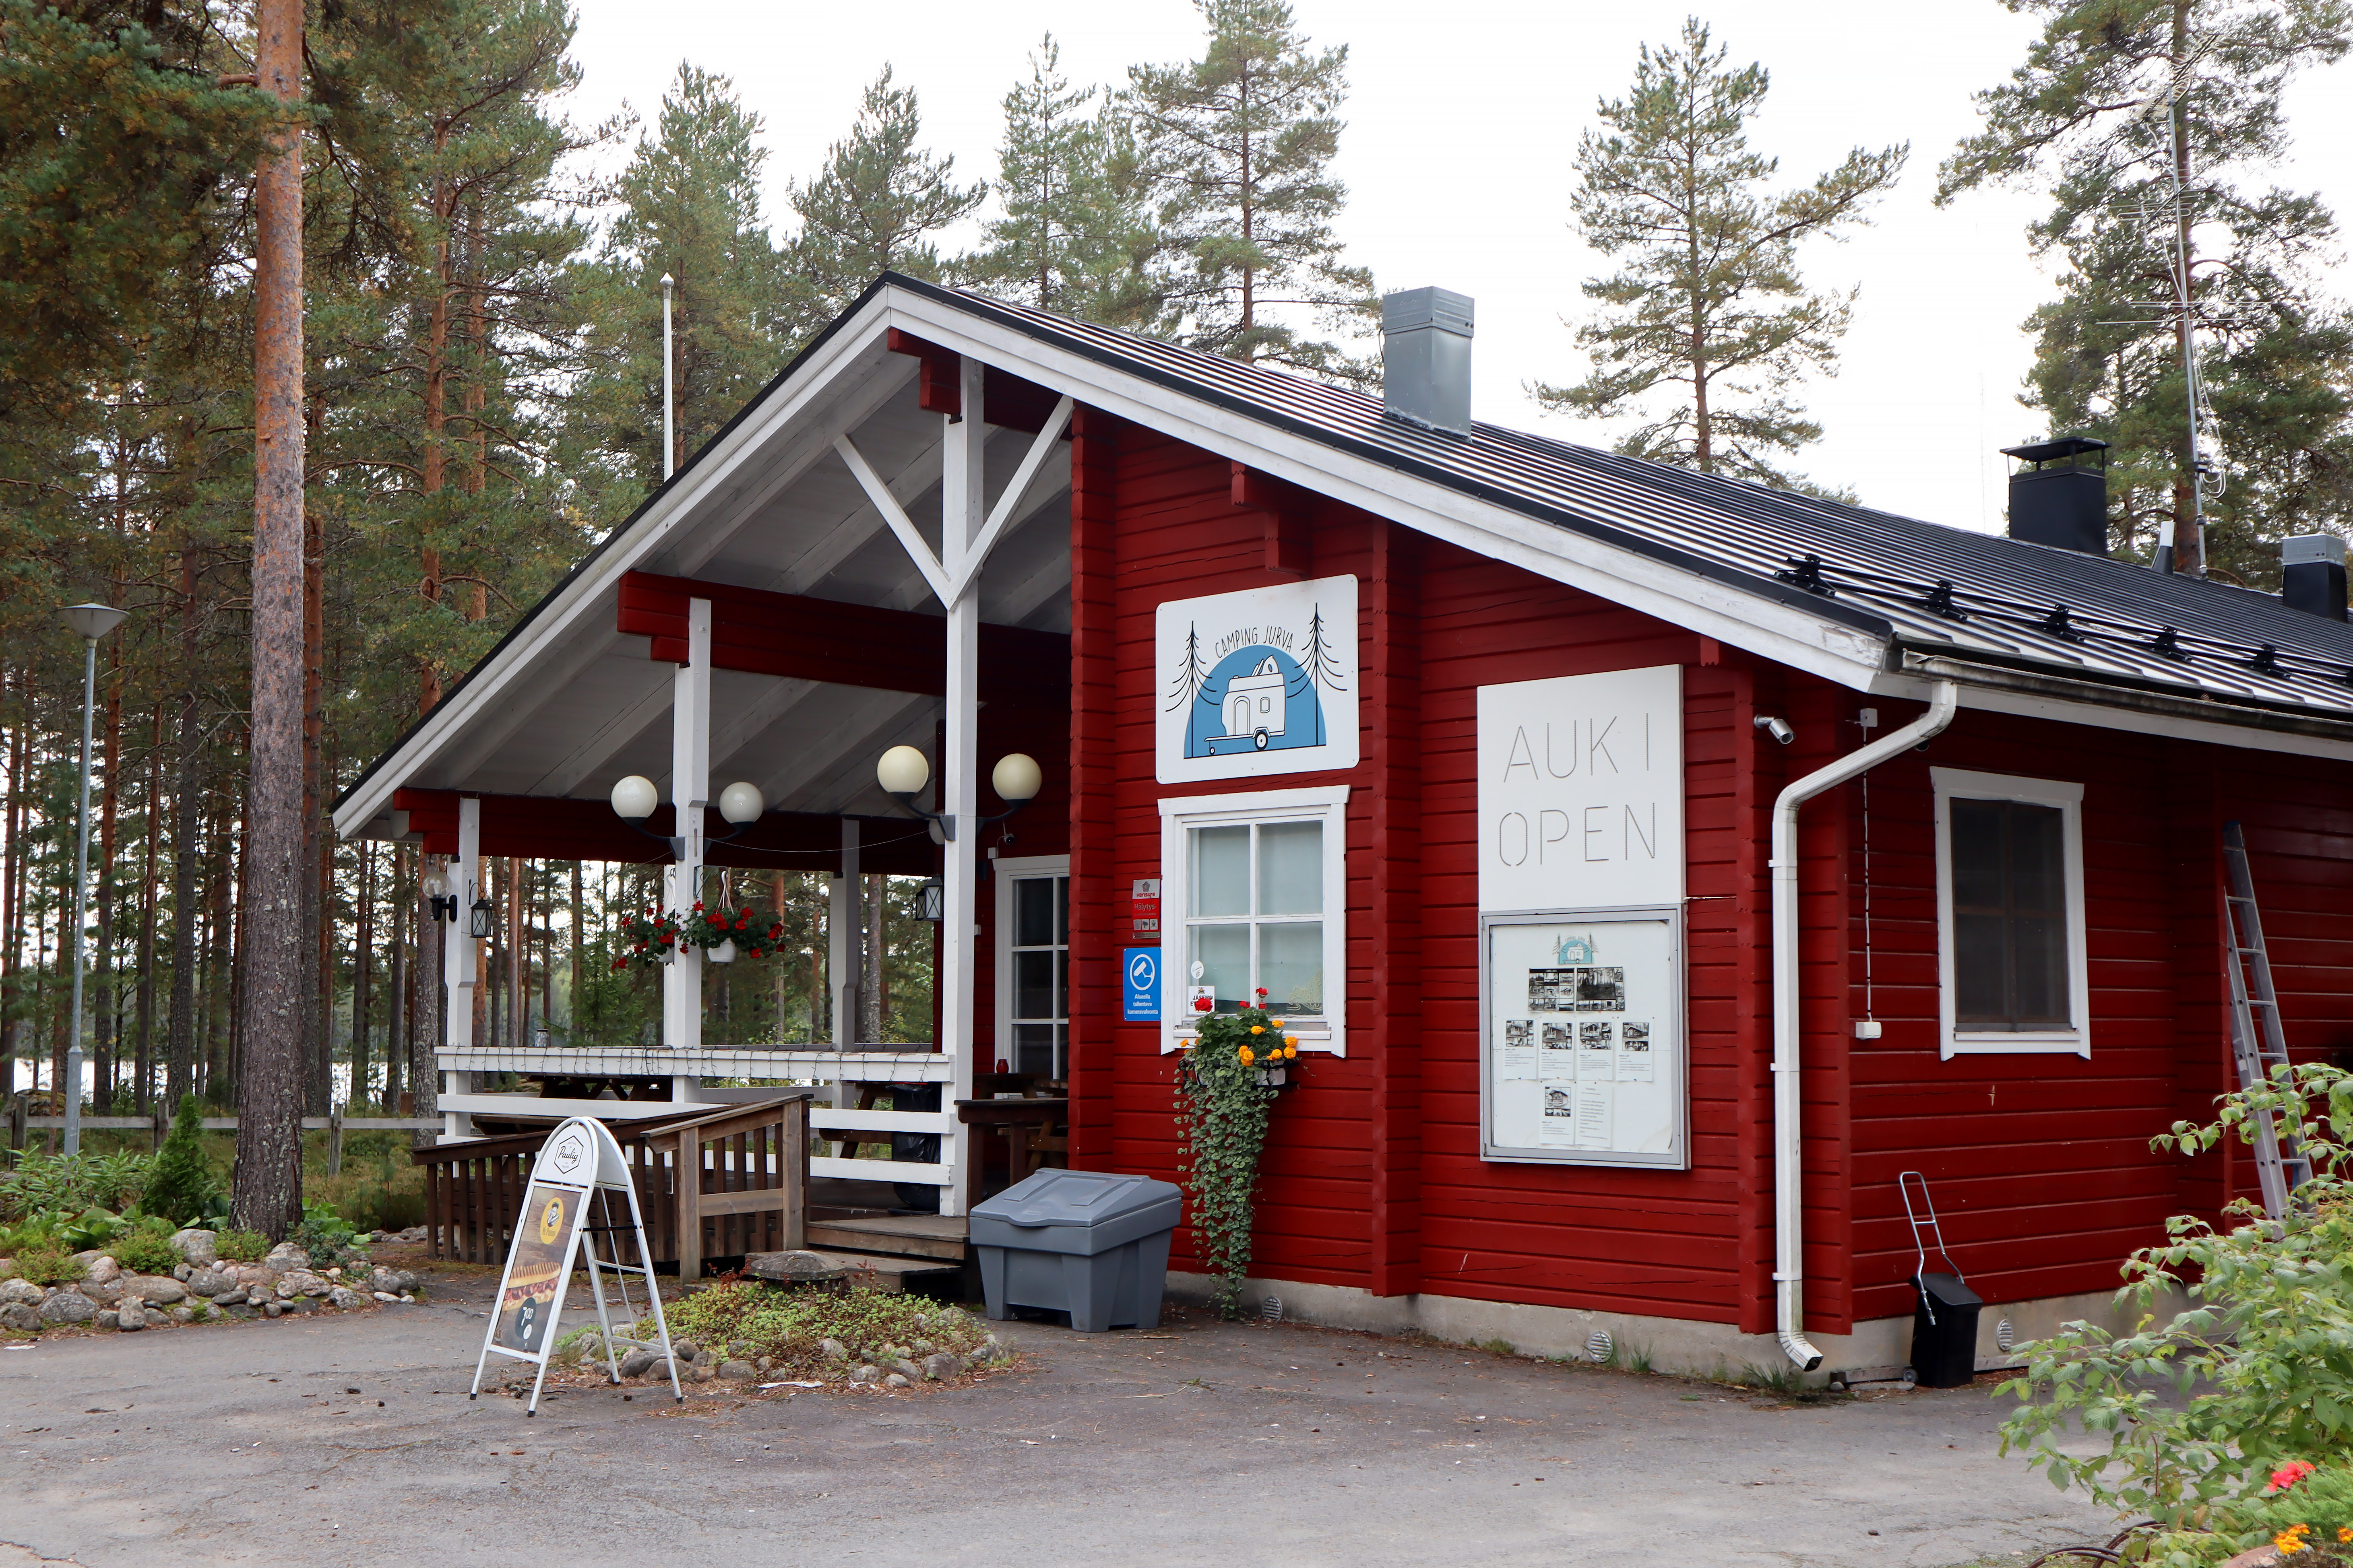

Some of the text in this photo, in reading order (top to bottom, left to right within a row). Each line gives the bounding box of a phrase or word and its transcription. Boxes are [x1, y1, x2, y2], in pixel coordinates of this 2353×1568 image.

[1215, 625, 1293, 658] CAMPING JURVA
[1504, 712, 1649, 783] AUKI
[1499, 803, 1655, 867] OPEN
[1134, 903, 1157, 912] Hälytys-
[558, 1146, 578, 1164] Paulig
